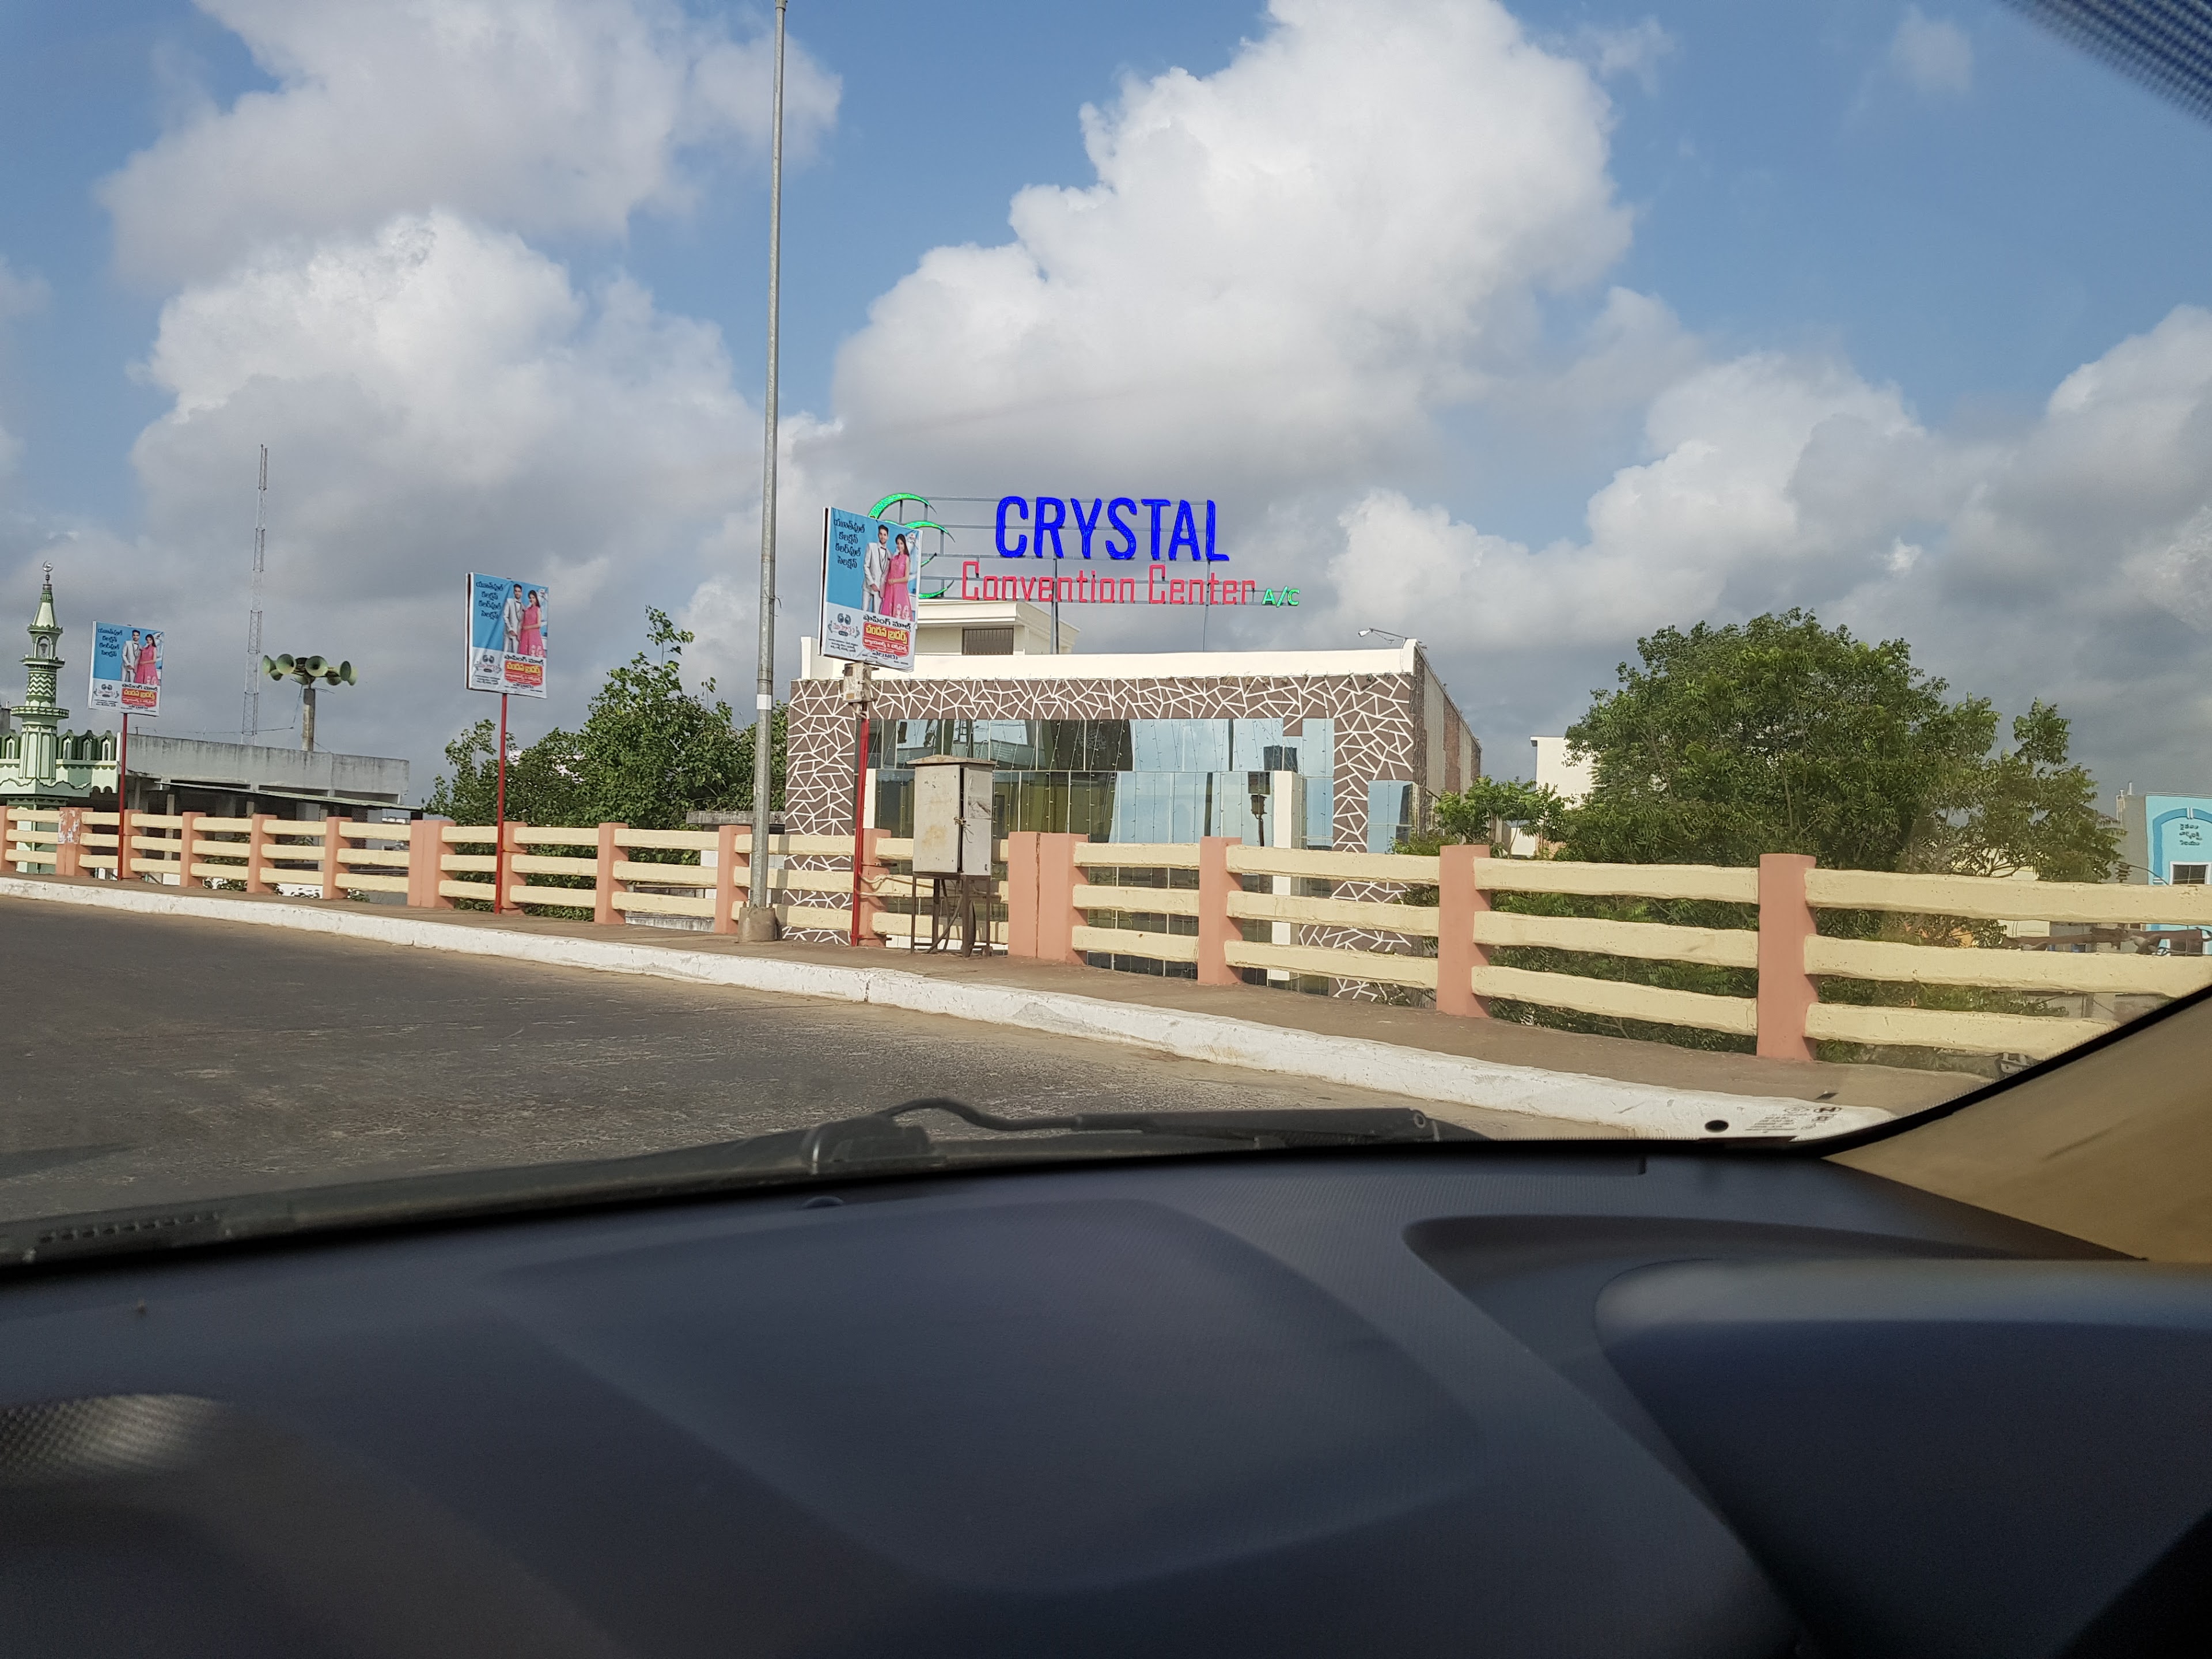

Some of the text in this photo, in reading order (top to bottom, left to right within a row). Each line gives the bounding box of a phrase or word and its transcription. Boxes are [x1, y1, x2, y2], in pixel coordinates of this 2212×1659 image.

[995, 495, 1230, 562] CRYSTAL
[962, 560, 1300, 607] Convention Center A/C
